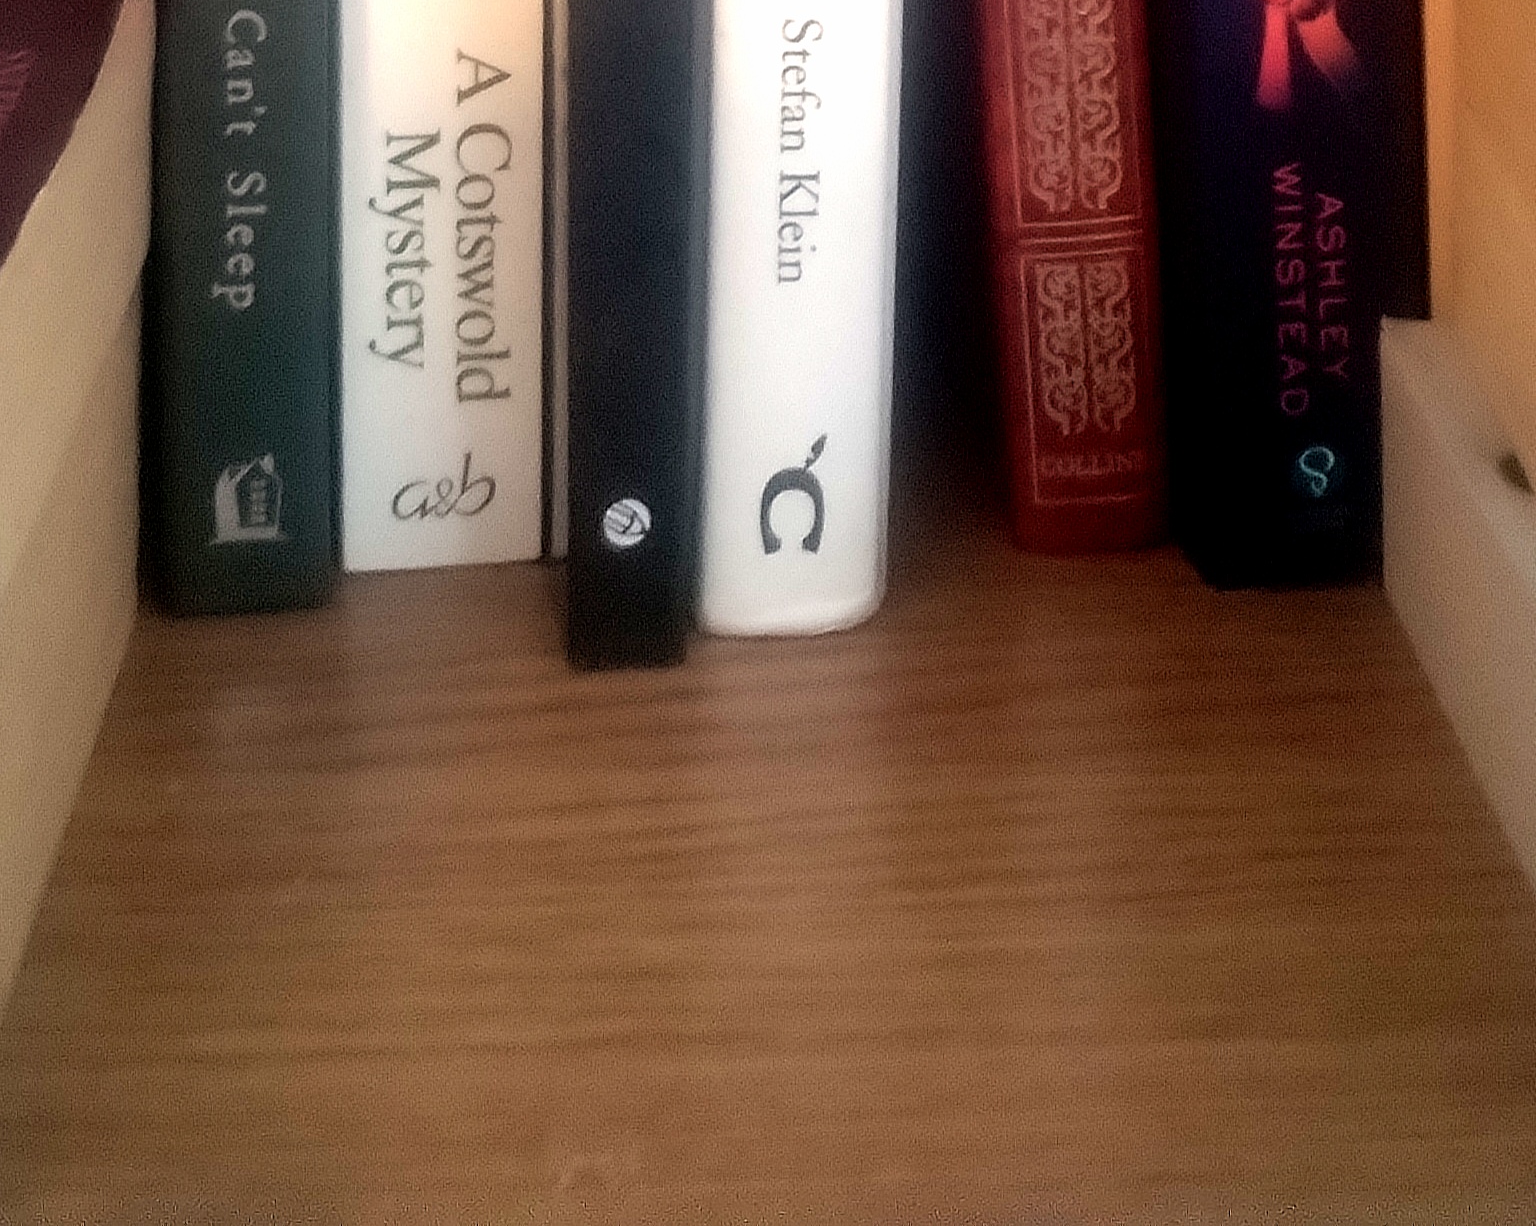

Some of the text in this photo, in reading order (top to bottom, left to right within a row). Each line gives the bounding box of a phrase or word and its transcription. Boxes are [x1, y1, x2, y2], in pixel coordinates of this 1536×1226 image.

[224, 9, 267, 137] Can't
[776, 18, 824, 284] Stefan Klein
[211, 169, 267, 311] Sleep
[368, 128, 441, 371] Mystery
[454, 46, 513, 404] A Cotswold
[1272, 161, 1311, 418] WINSTEAD
[1315, 192, 1352, 378] ASHLEY
